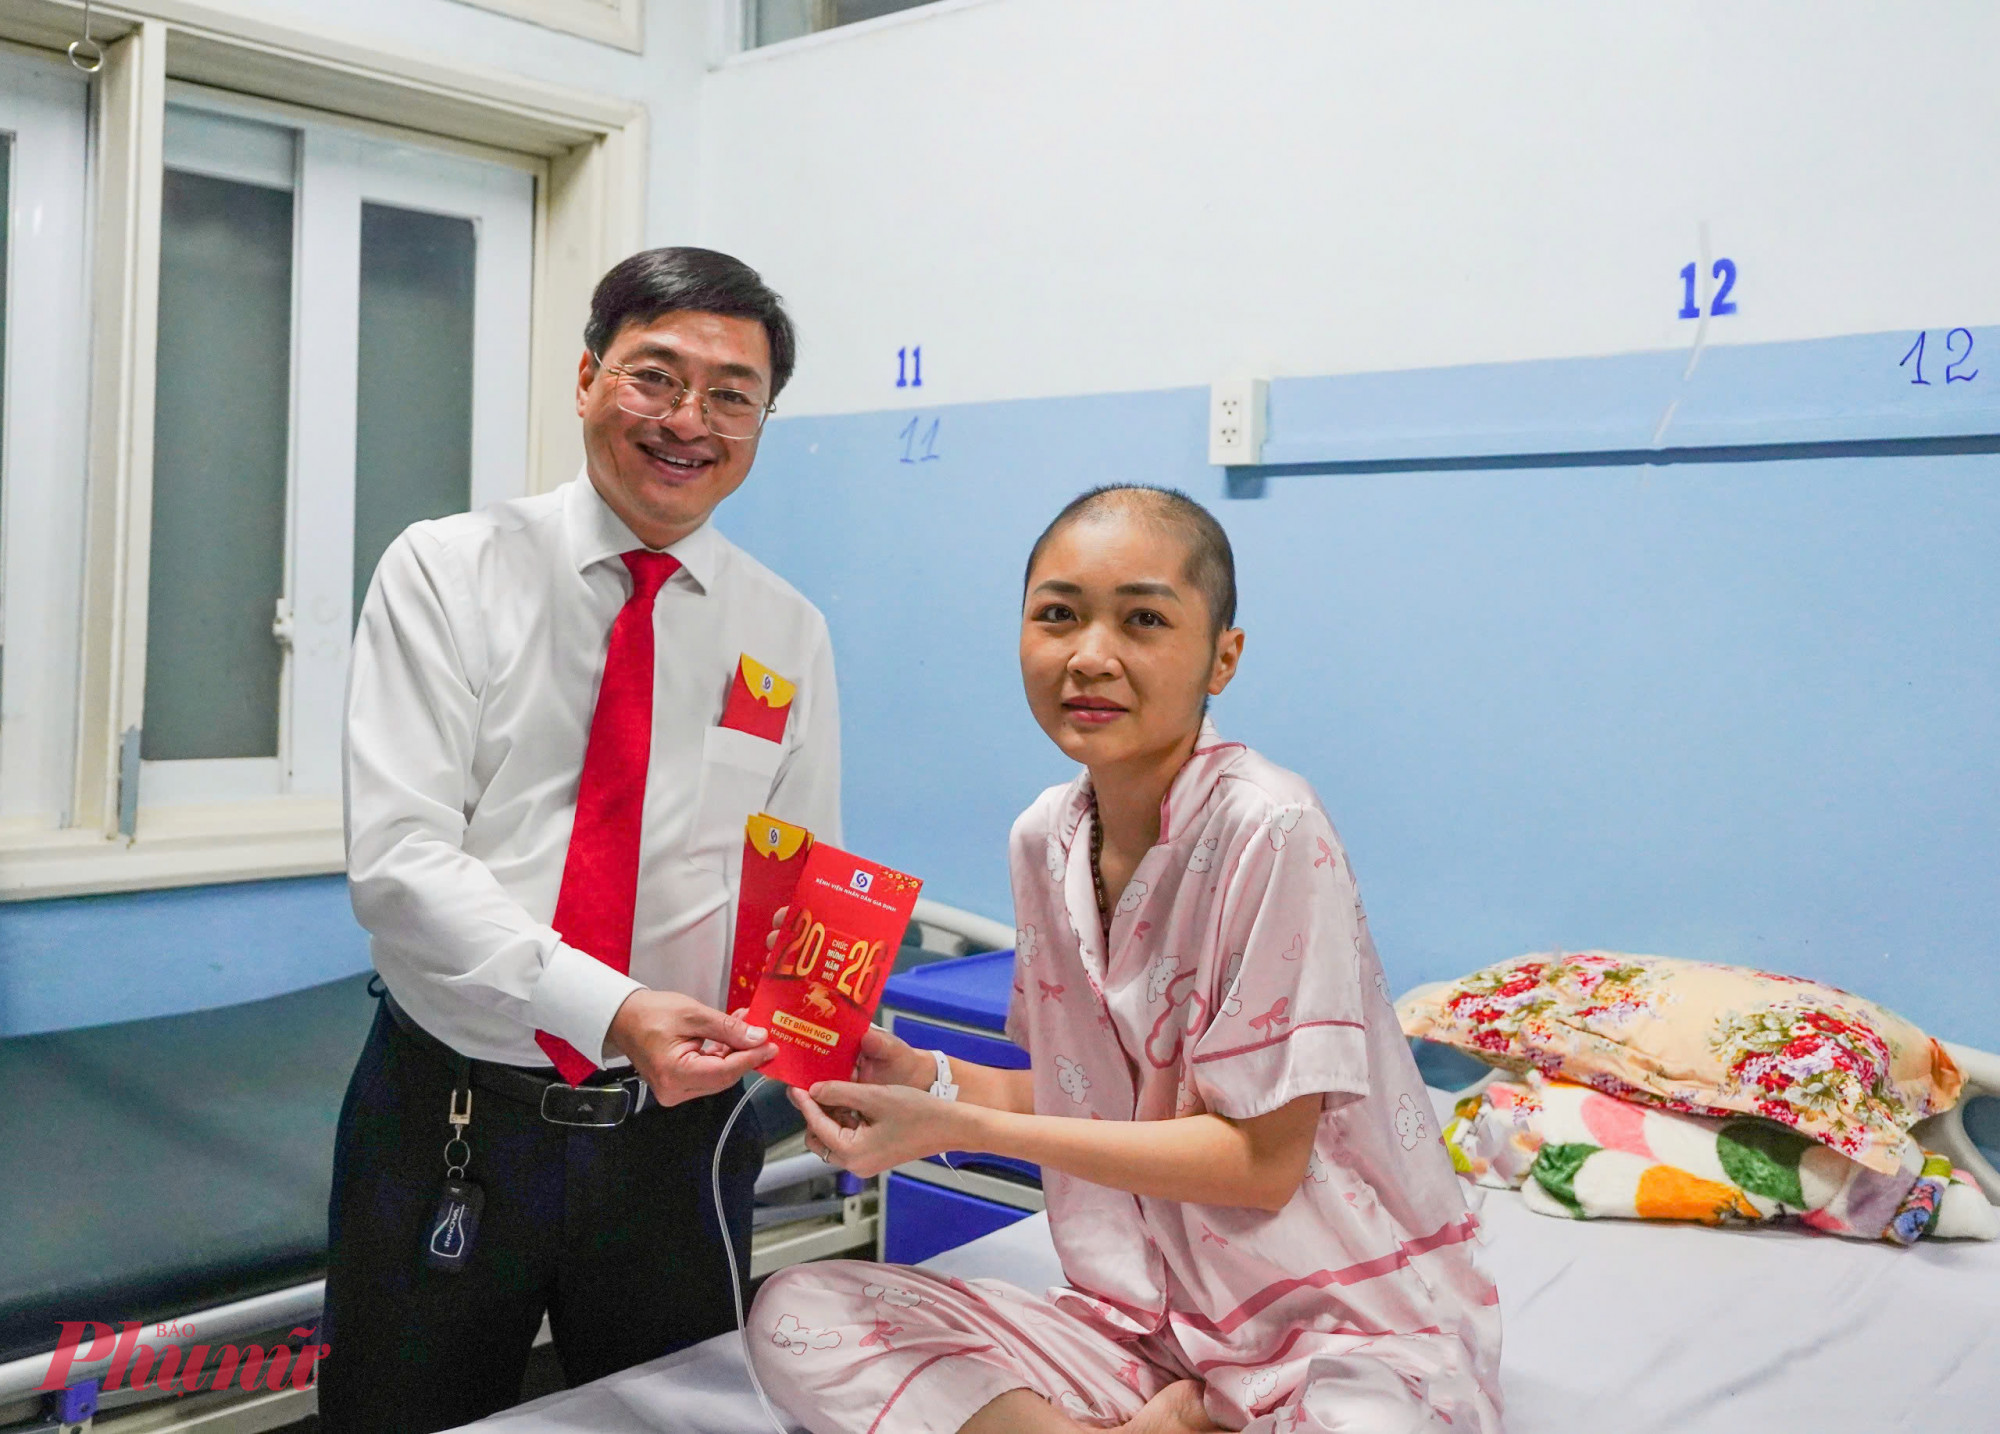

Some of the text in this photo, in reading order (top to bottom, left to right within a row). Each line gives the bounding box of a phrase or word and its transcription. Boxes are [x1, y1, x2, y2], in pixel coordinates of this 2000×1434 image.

[1678, 258, 1738, 319] 12
[896, 345, 922, 388] 11
[1900, 327, 1979, 385] 12
[899, 415, 940, 464] 11
[844, 888, 860, 898] NHÂN
[780, 1015, 793, 1026] TẾT
[770, 1028, 831, 1056] Happy New Year
[444, 1208, 460, 1248] INNOVA
